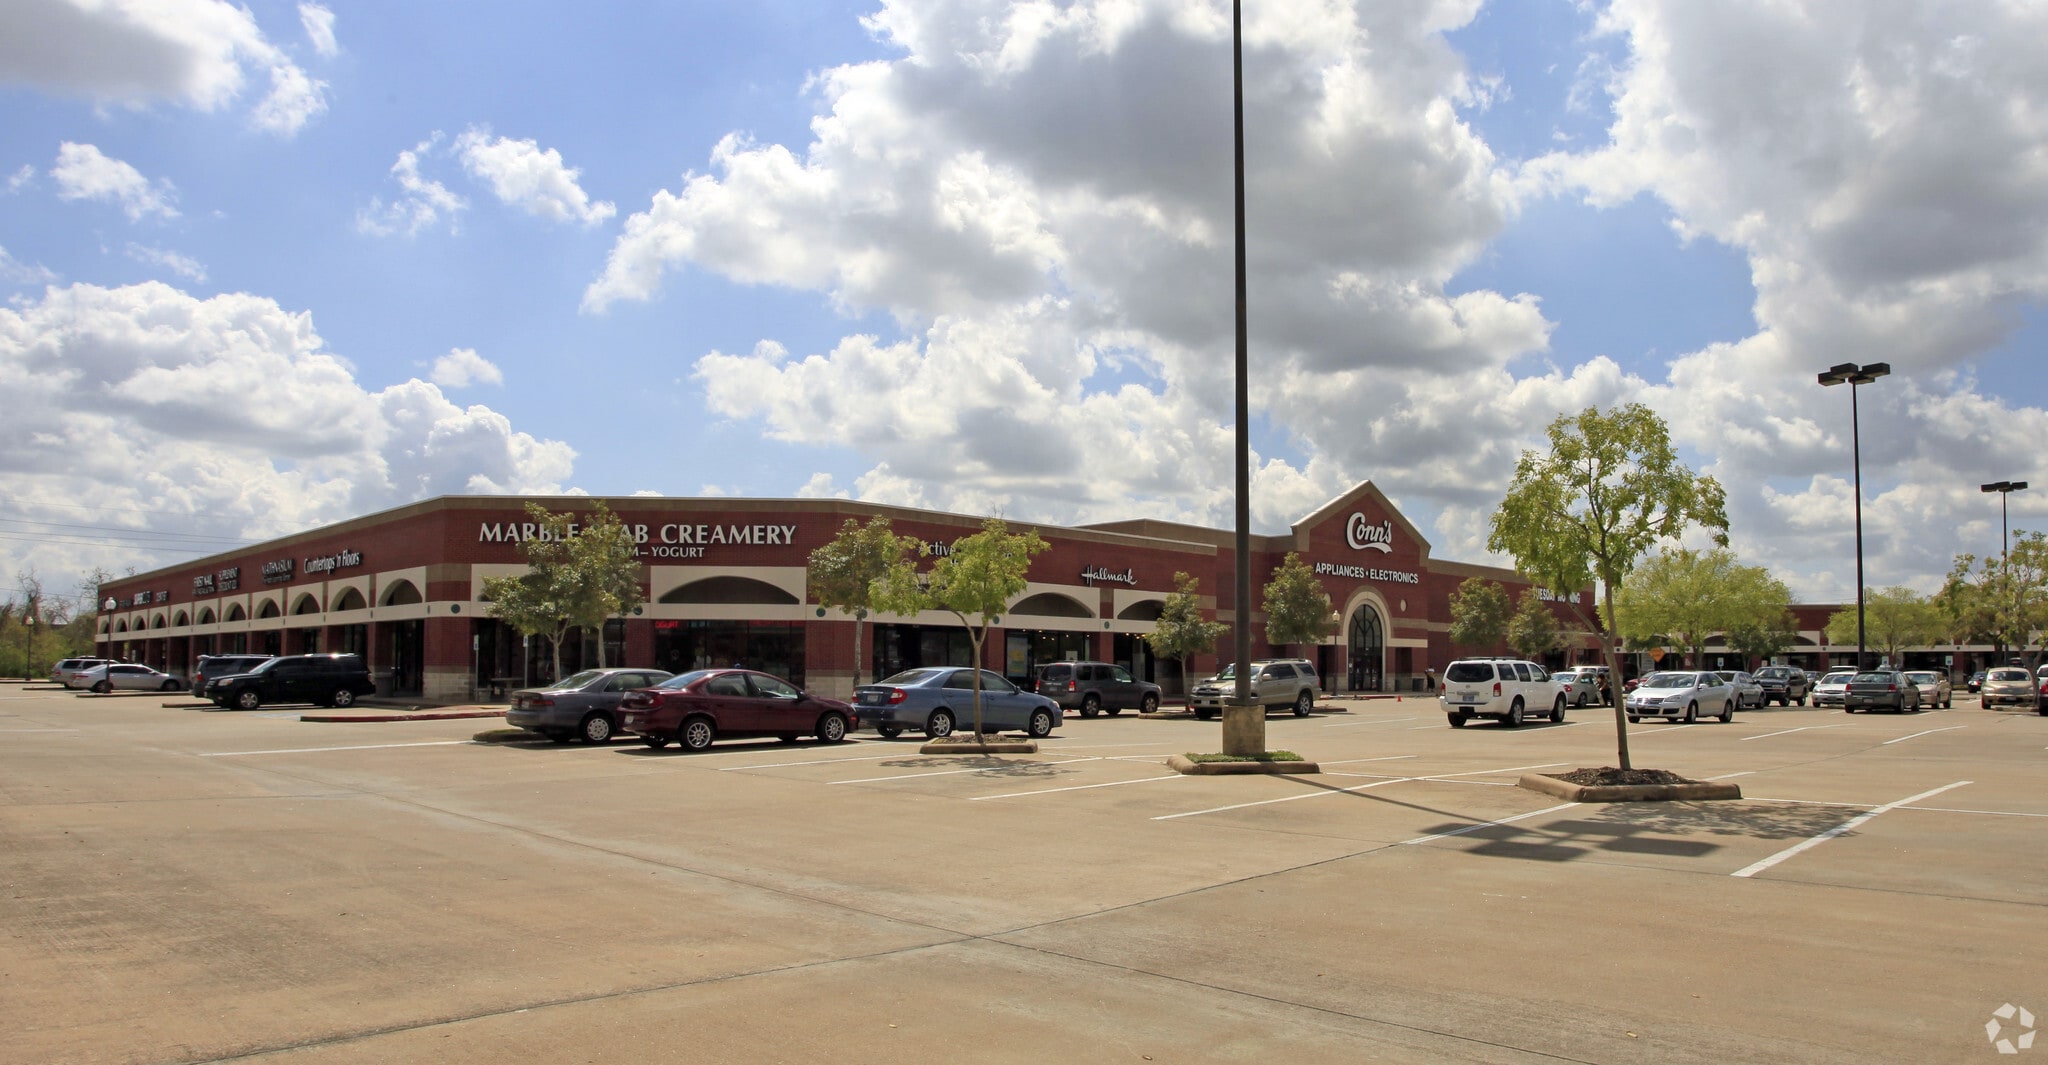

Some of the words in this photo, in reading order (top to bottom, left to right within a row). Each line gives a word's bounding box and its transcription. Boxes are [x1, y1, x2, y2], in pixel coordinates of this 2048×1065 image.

[660, 523, 796, 545] CREAMERY
[1347, 512, 1392, 554] Conn's
[303, 556, 335, 575] Countertops
[341, 549, 360, 567] Floors
[651, 546, 705, 558] YOGURT
[1081, 565, 1138, 587] Hallmark
[1315, 562, 1365, 579] APPLIANCES
[1370, 568, 1419, 584] ELECTRONICS
